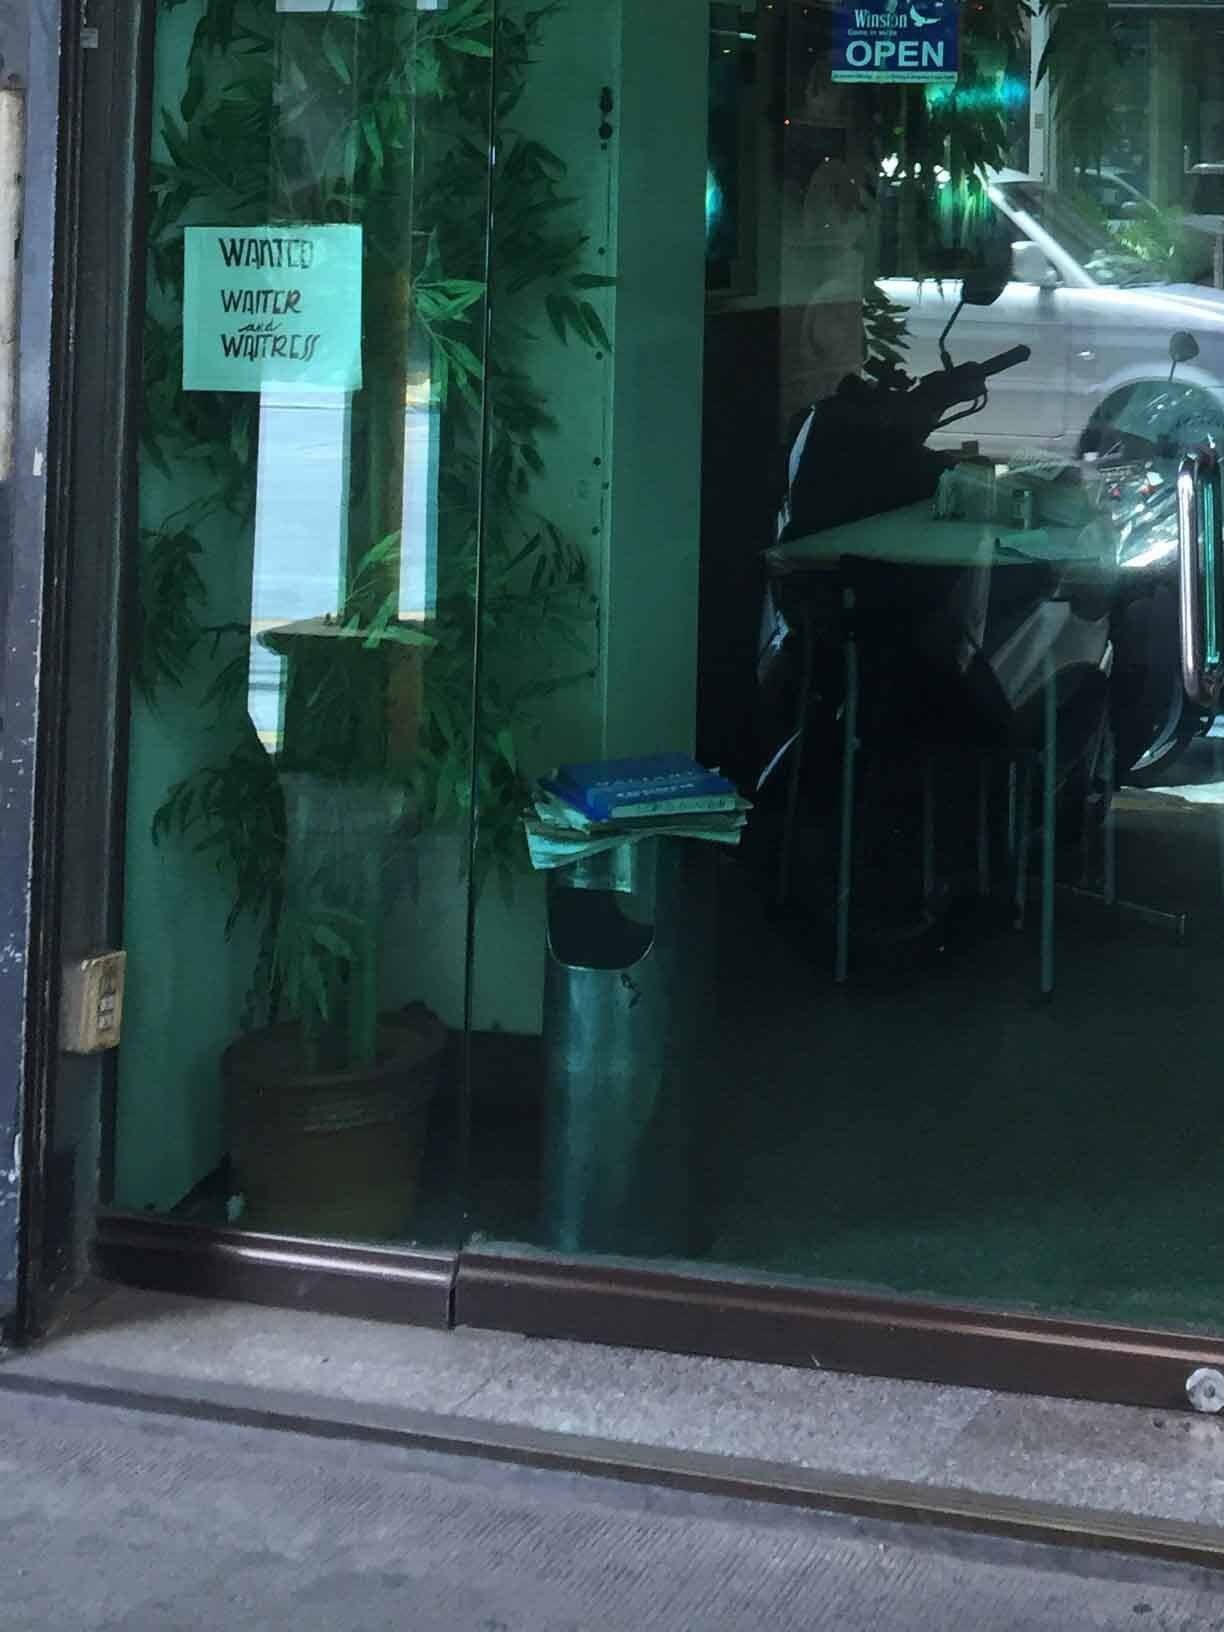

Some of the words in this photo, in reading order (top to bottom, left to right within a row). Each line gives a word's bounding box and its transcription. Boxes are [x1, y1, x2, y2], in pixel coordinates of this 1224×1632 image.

[854, 9, 907, 28] Winston
[845, 40, 944, 67] OPEN
[218, 238, 314, 268] WANTED
[220, 289, 302, 315] WAITER
